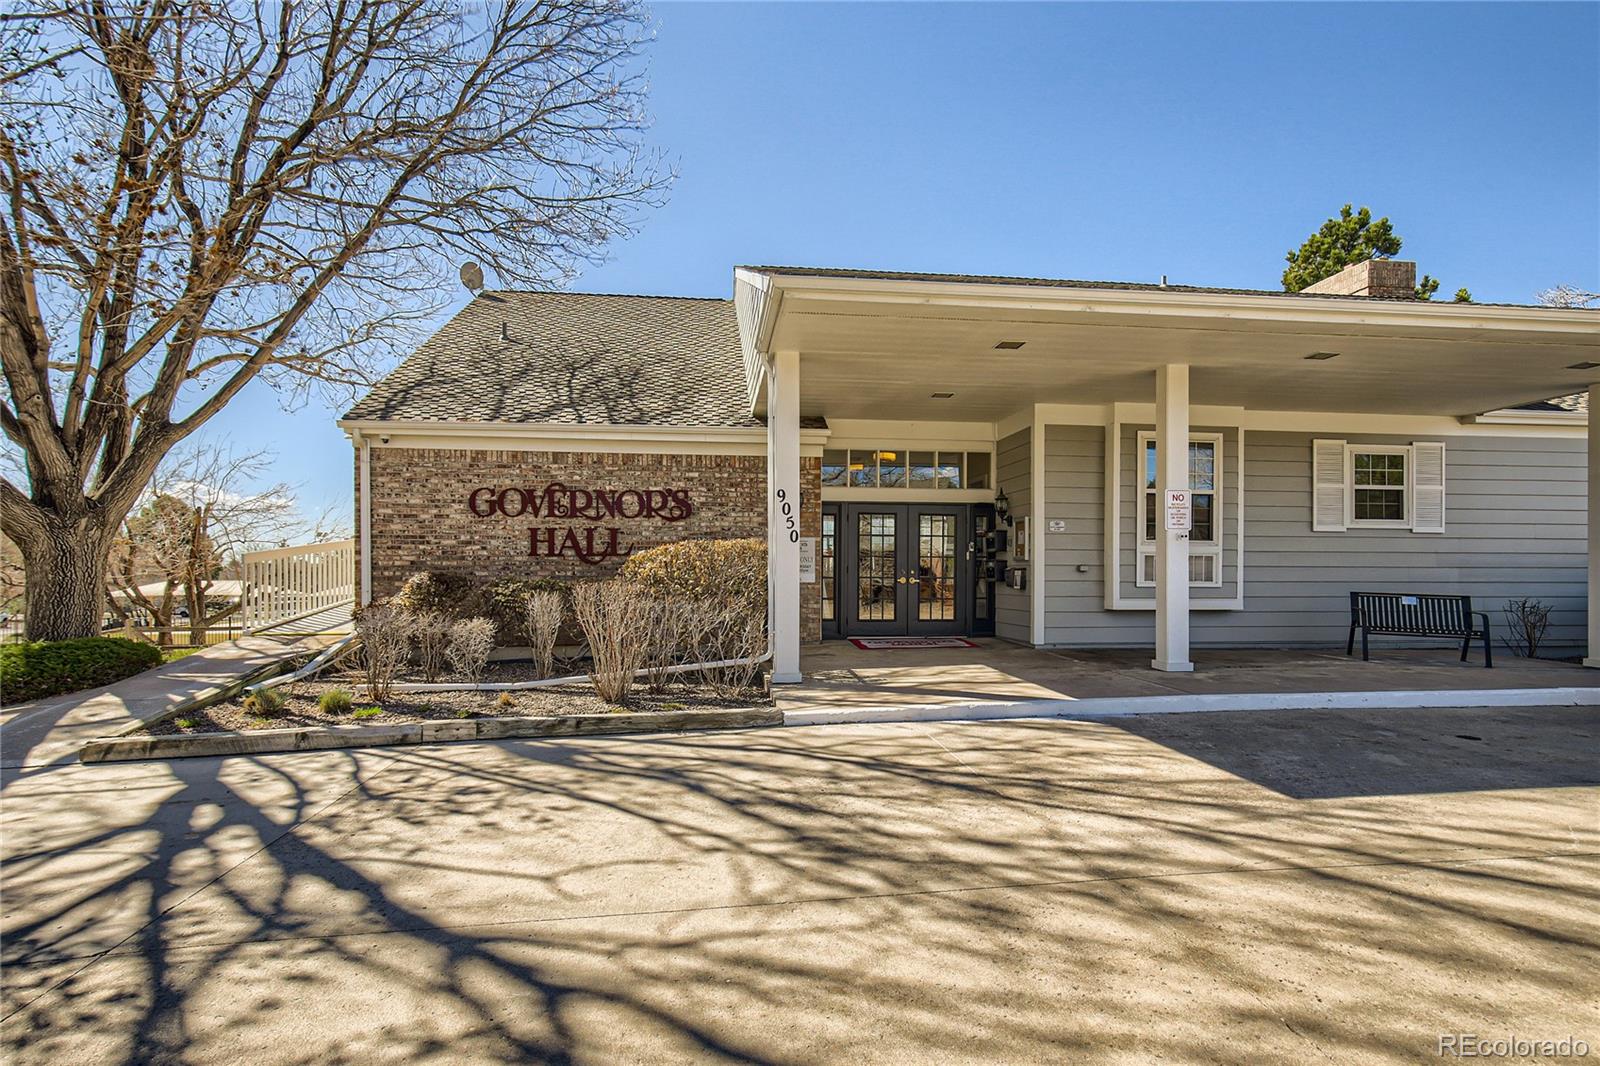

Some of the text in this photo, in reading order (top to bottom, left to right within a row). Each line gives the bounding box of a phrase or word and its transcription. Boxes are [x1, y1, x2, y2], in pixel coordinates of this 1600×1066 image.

[468, 482, 693, 522] GOVERNOR'S
[777, 489, 799, 543] 9050
[527, 526, 634, 565] HALL
